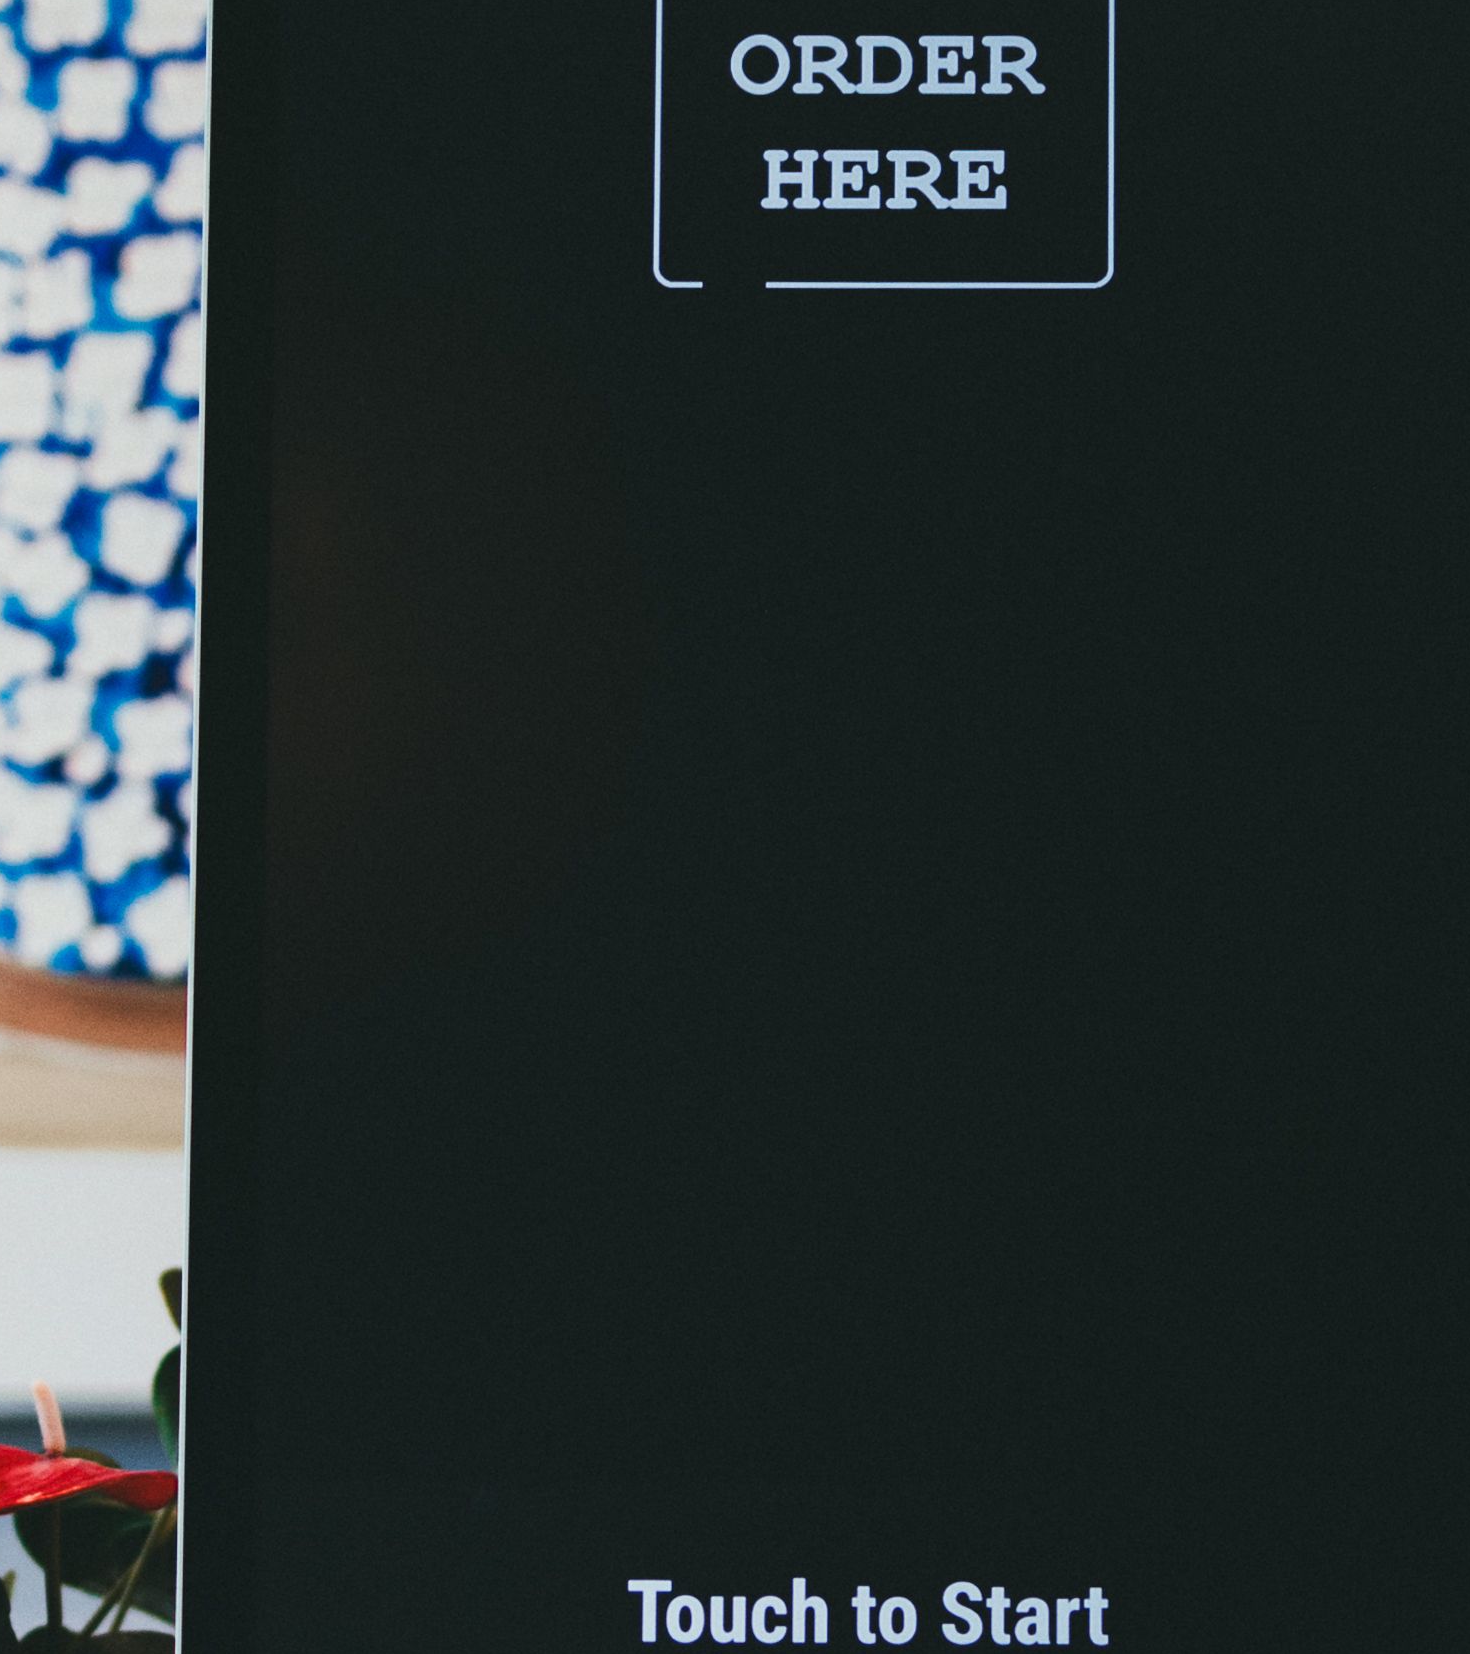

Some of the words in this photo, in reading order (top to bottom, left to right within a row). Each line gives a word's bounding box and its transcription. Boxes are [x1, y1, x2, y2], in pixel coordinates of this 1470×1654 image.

[731, 34, 1046, 95] ORDER
[761, 150, 1007, 209] HERE
[628, 1578, 828, 1644] Touch
[852, 1586, 917, 1645] to
[942, 1581, 1108, 1645] Start
